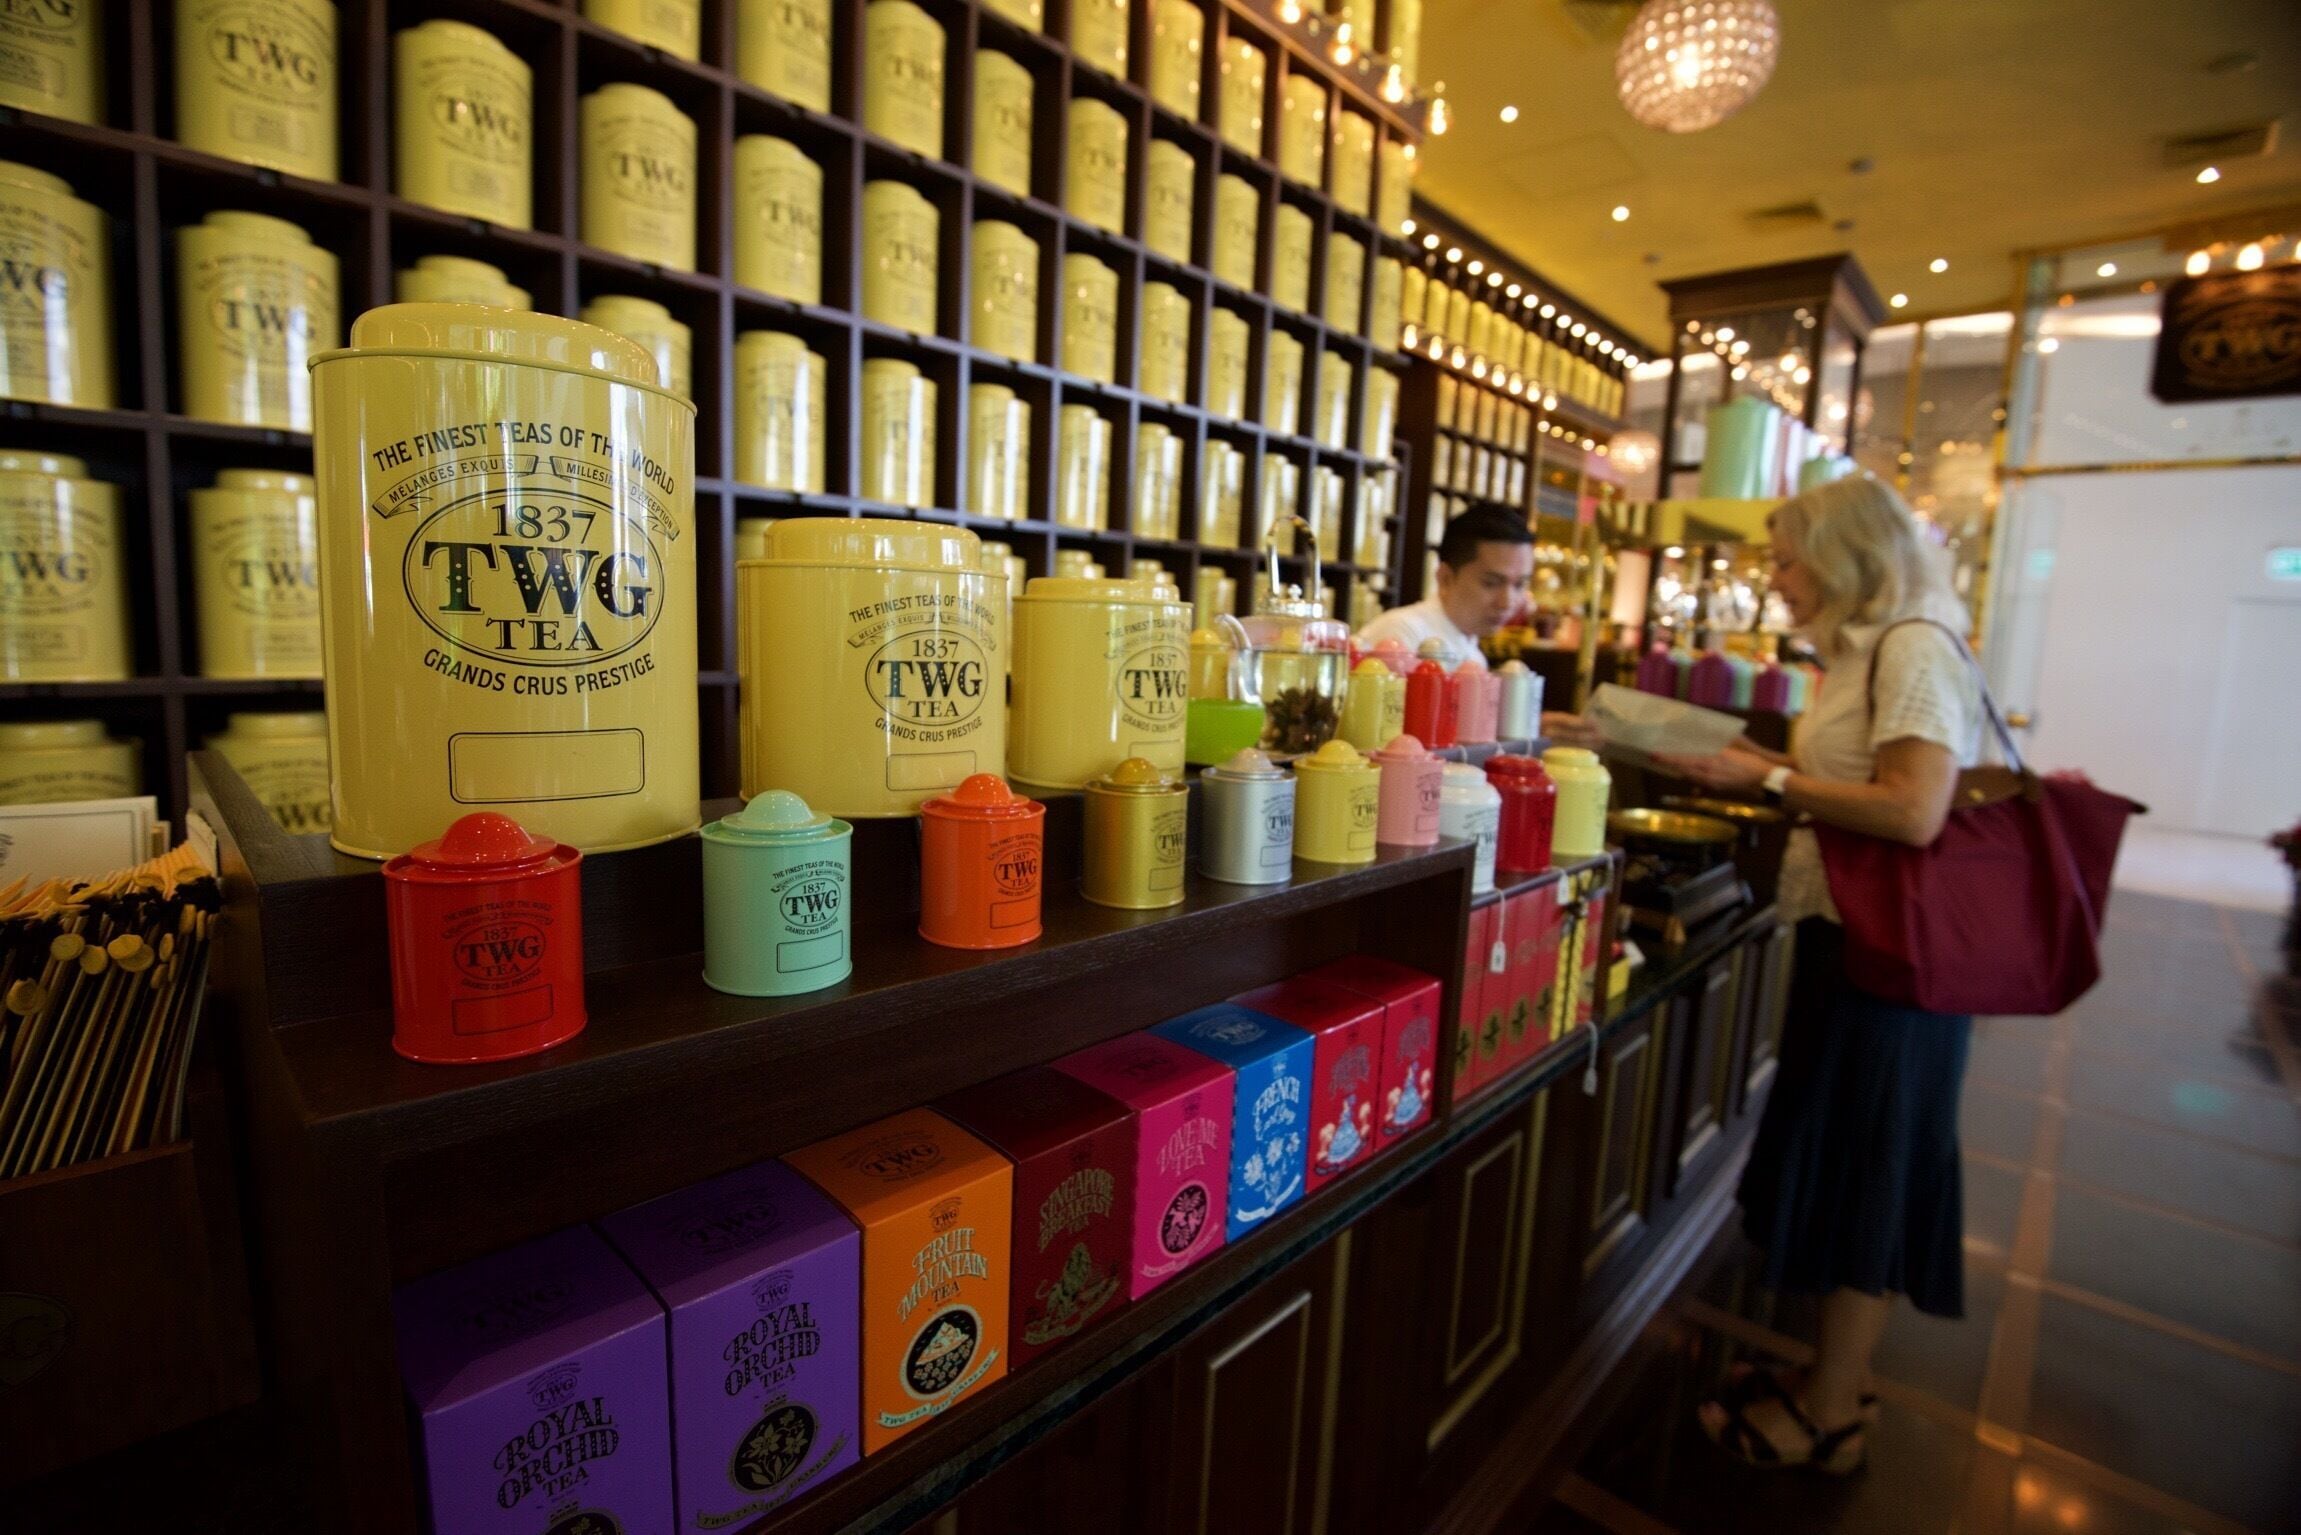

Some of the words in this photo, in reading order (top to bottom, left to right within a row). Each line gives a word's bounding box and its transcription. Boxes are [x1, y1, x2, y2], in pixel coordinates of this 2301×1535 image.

[215, 30, 317, 84] TWG
[436, 95, 521, 142] TWG
[373, 440, 412, 472] THE
[413, 423, 487, 458] FINEST
[494, 422, 552, 444] TEAS
[560, 426, 585, 448] OF
[631, 449, 675, 495] WORLD
[461, 458, 514, 474] EXQUIS
[492, 504, 596, 544] 1837
[423, 541, 654, 619] TWG
[849, 607, 873, 623] THE
[874, 597, 912, 616] FINEST
[915, 595, 941, 607] TEAS
[944, 595, 955, 606] OF
[486, 618, 603, 651] TEA
[912, 639, 959, 659] 1837
[424, 649, 506, 691] GRANDS
[513, 675, 568, 696] CRUS
[575, 653, 655, 693] PRESTIGE
[877, 660, 982, 698] TWG
[1125, 669, 1187, 698] TWG
[907, 700, 959, 717] TEA
[1145, 700, 1176, 714] TEA
[875, 717, 916, 741] GRANDS
[919, 730, 944, 742] CRUS
[947, 716, 983, 740] PRESTIGE
[773, 870, 785, 880] THE
[785, 864, 804, 875] FINEST
[805, 861, 818, 870] TEAS
[999, 858, 1037, 880] TWG
[803, 881, 826, 894] 1837
[785, 889, 839, 917] TWG
[801, 911, 827, 924] TEA
[484, 926, 519, 941] 1837
[785, 925, 806, 936] GRANDS
[806, 926, 820, 936] CRUS
[460, 936, 541, 968] TWG
[1253, 1075, 1301, 1117] FRENCH
[1171, 1144, 1206, 1177] TEA
[911, 1227, 976, 1277] FRUIT
[757, 1282, 789, 1304] TWG
[897, 1251, 988, 1322] MOUNTAIN
[932, 1280, 960, 1303] TEA
[723, 1302, 816, 1368] ROYAL
[725, 1331, 820, 1396] ORCHID
[760, 1362, 796, 1388] TEA
[534, 1377, 575, 1404] TWG
[494, 1396, 613, 1478] ROYAL
[497, 1428, 620, 1509] ORCHID
[543, 1466, 589, 1498] TEA
